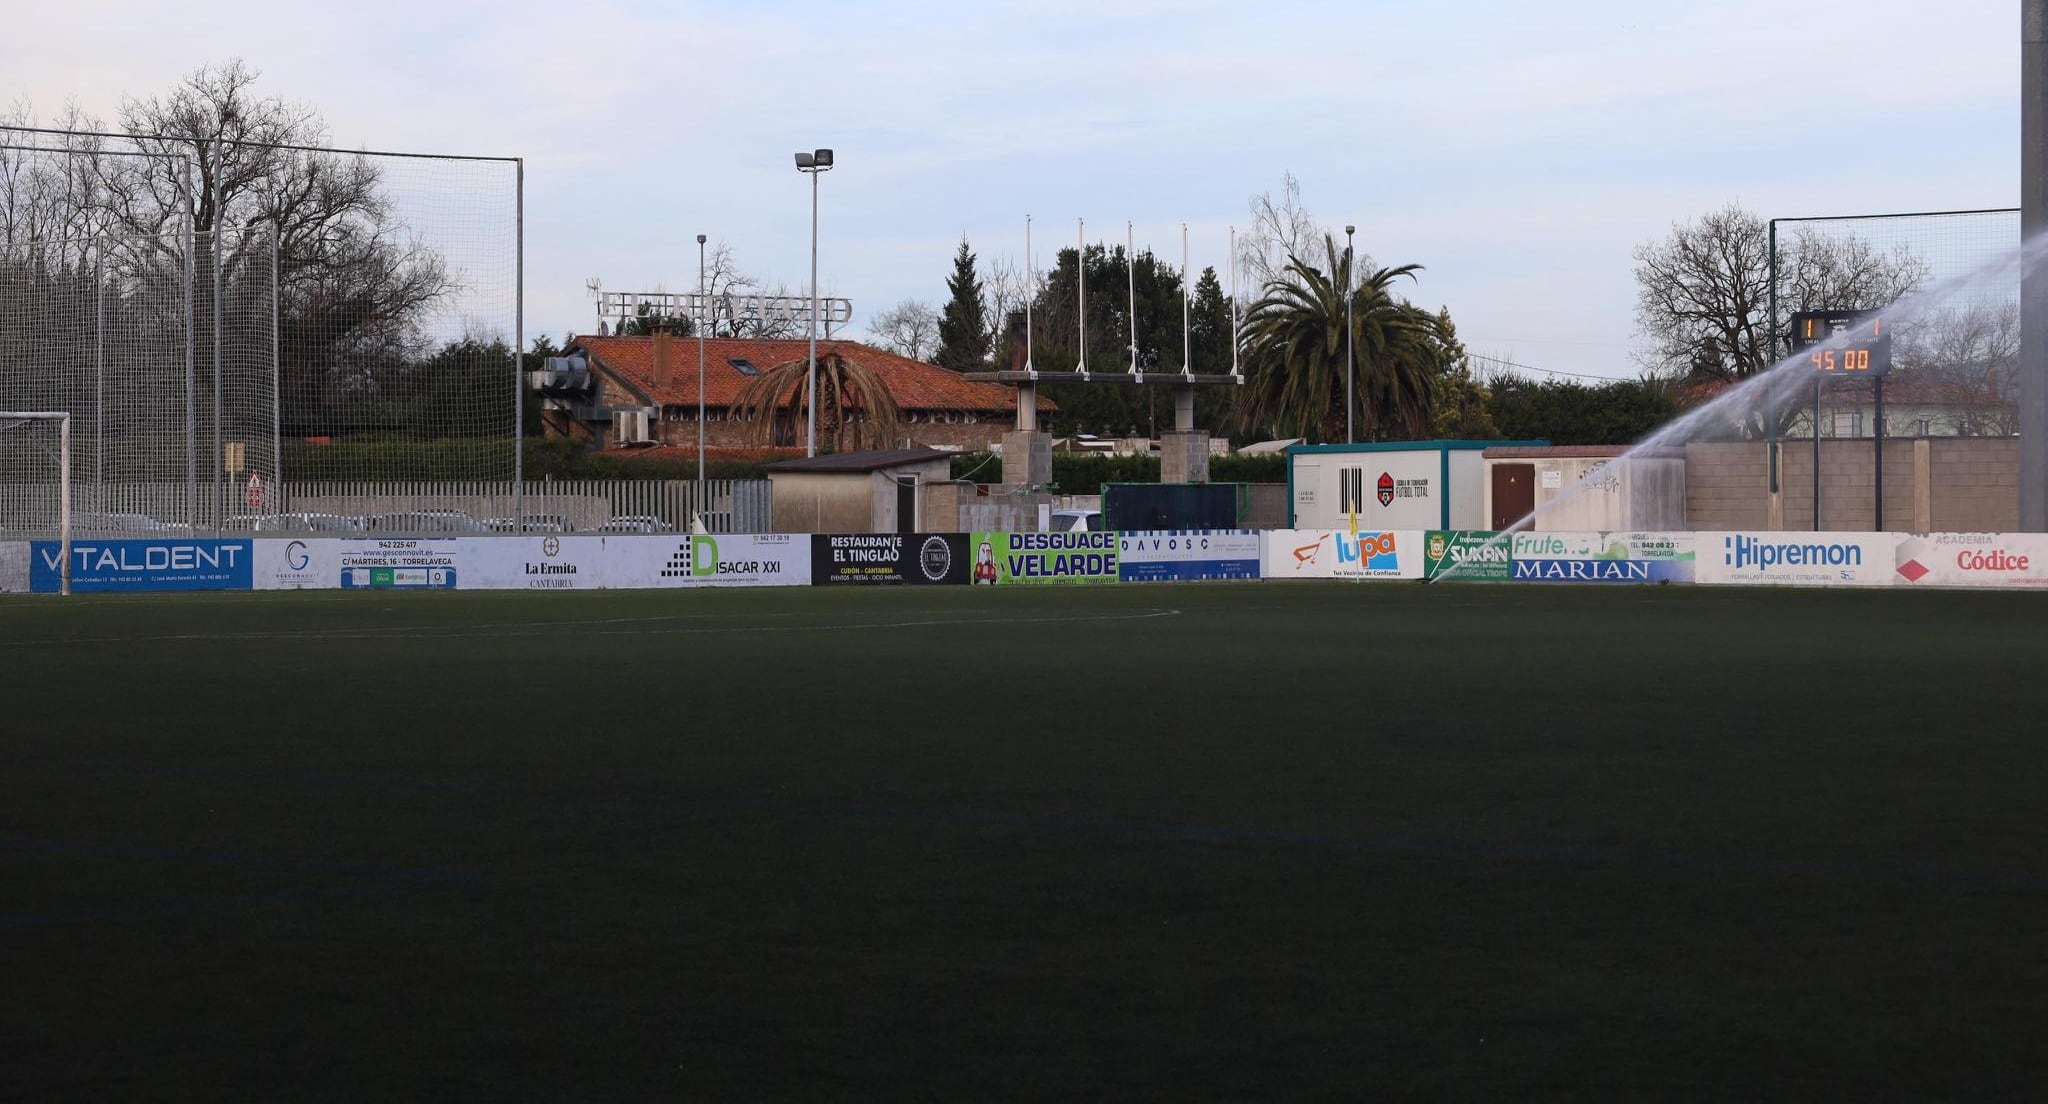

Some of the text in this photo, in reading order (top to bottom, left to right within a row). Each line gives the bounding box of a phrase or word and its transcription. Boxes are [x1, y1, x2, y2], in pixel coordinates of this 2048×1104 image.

[1844, 350, 1869, 370] 00
[1009, 533, 1114, 550] DESGUACE
[1514, 536, 1589, 554] Frute
[1935, 535, 1993, 544] ACADEMIA
[42, 545, 243, 571] VTALDENT
[834, 549, 900, 562] EL TINGLAO
[1335, 532, 1396, 567] lupa
[1736, 534, 1861, 571] Hipremon
[402, 558, 452, 566] TORRELAVEGA
[526, 562, 577, 574] La Ermita
[763, 560, 780, 573] XXI
[1008, 554, 1116, 576] VELARDE
[1957, 549, 2029, 571] Códice
[1515, 561, 1650, 580] MARIAN
